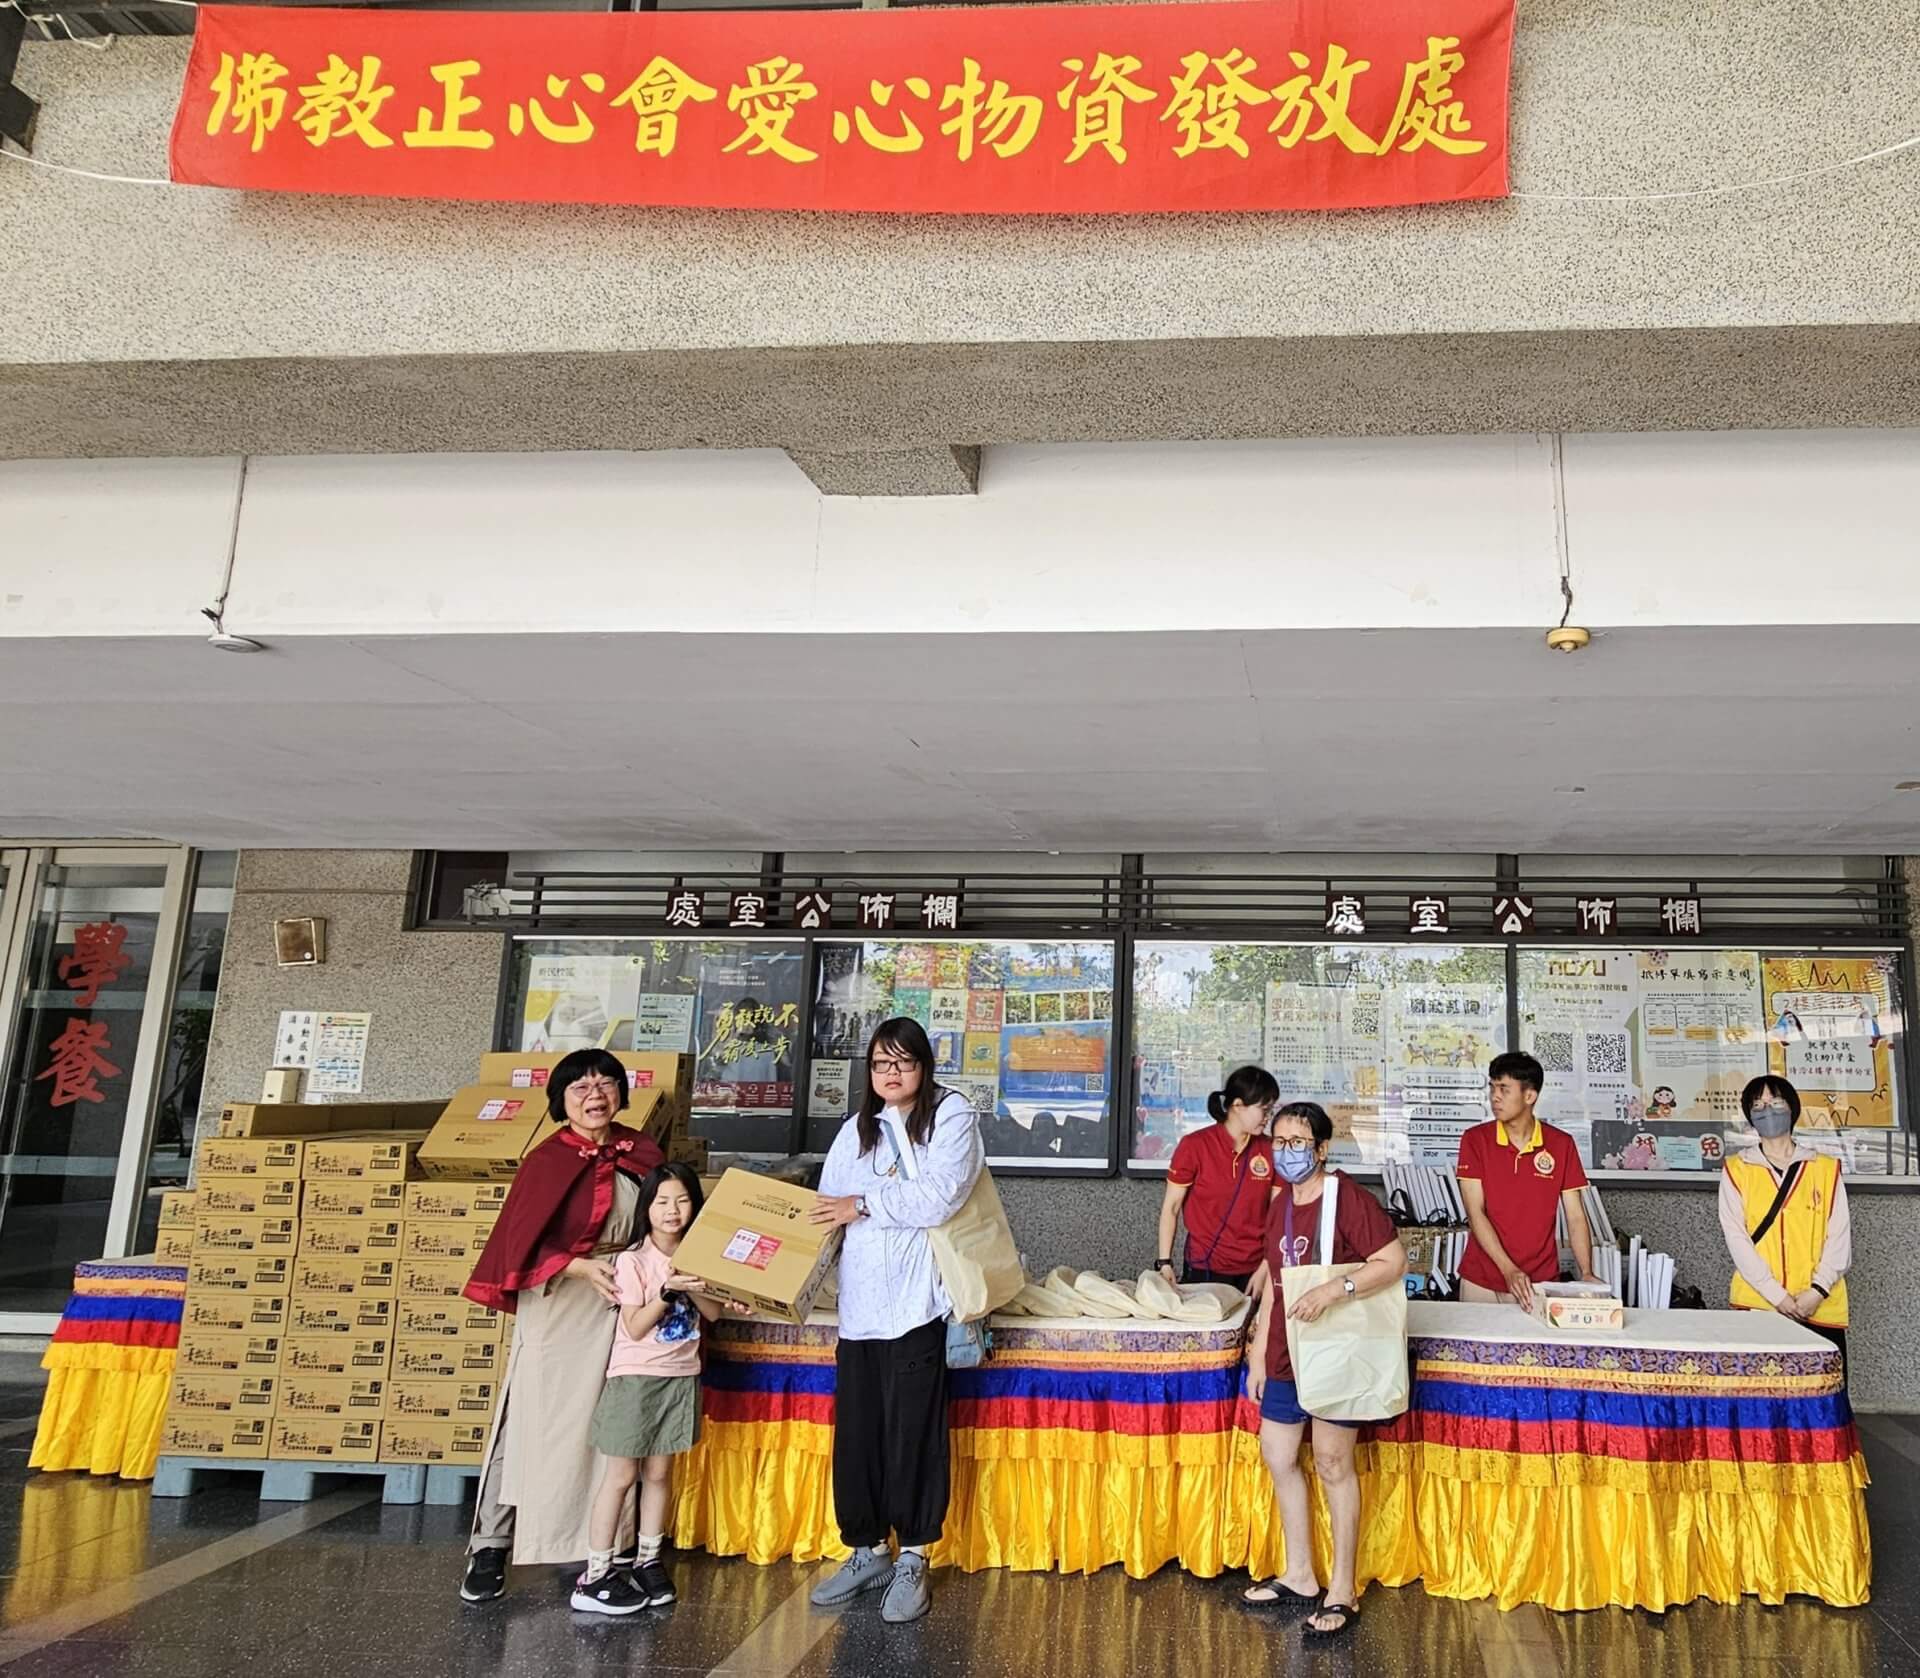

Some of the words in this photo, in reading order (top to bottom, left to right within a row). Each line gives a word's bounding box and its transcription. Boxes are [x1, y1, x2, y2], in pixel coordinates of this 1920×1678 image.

[206, 36, 1488, 164] 佛教正心會愛心物資發放處
[665, 892, 957, 928] 處室公佈欄
[1326, 896, 1700, 935] 處室公佈欄
[34, 921, 133, 1107] 學餐
[1700, 1136, 1721, 1157] 免
